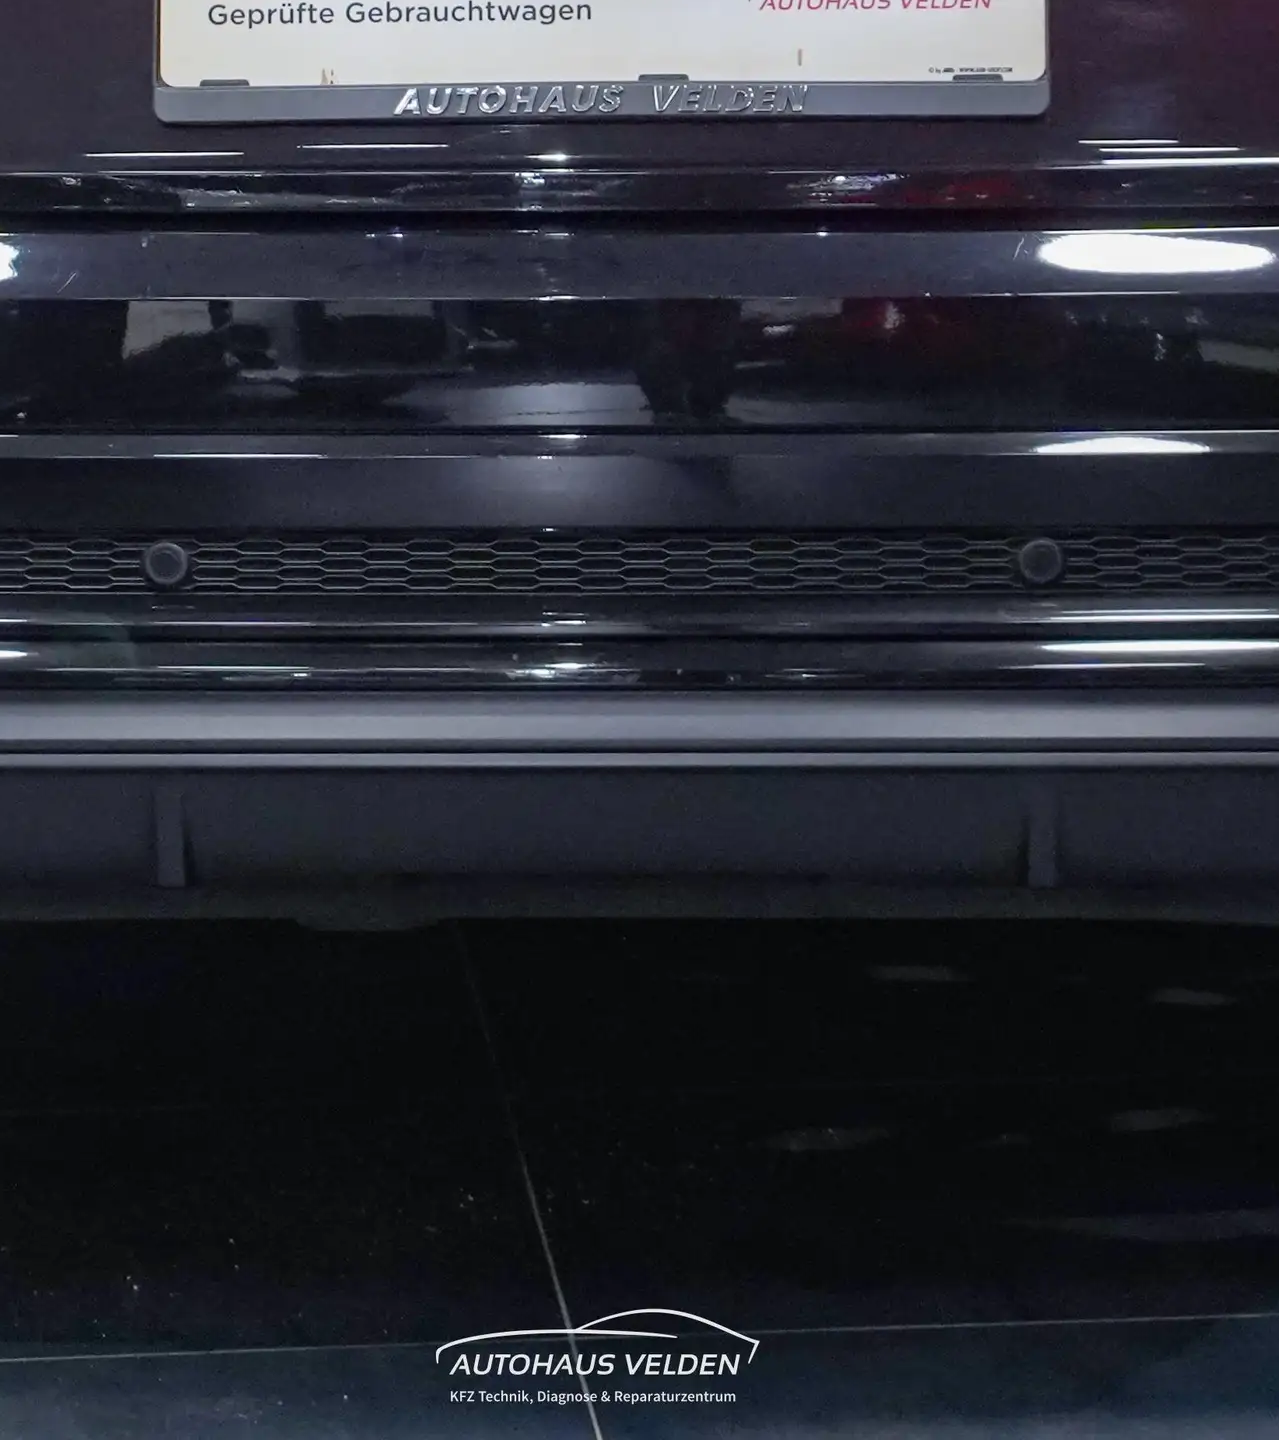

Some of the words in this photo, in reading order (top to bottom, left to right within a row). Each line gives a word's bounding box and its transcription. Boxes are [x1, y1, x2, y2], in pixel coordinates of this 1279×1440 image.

[208, 2, 335, 29] Geprüfte
[345, 0, 593, 26] Gebrauchtwagen
[393, 85, 624, 115] AUTOHAUS
[651, 84, 808, 112] VELDEN
